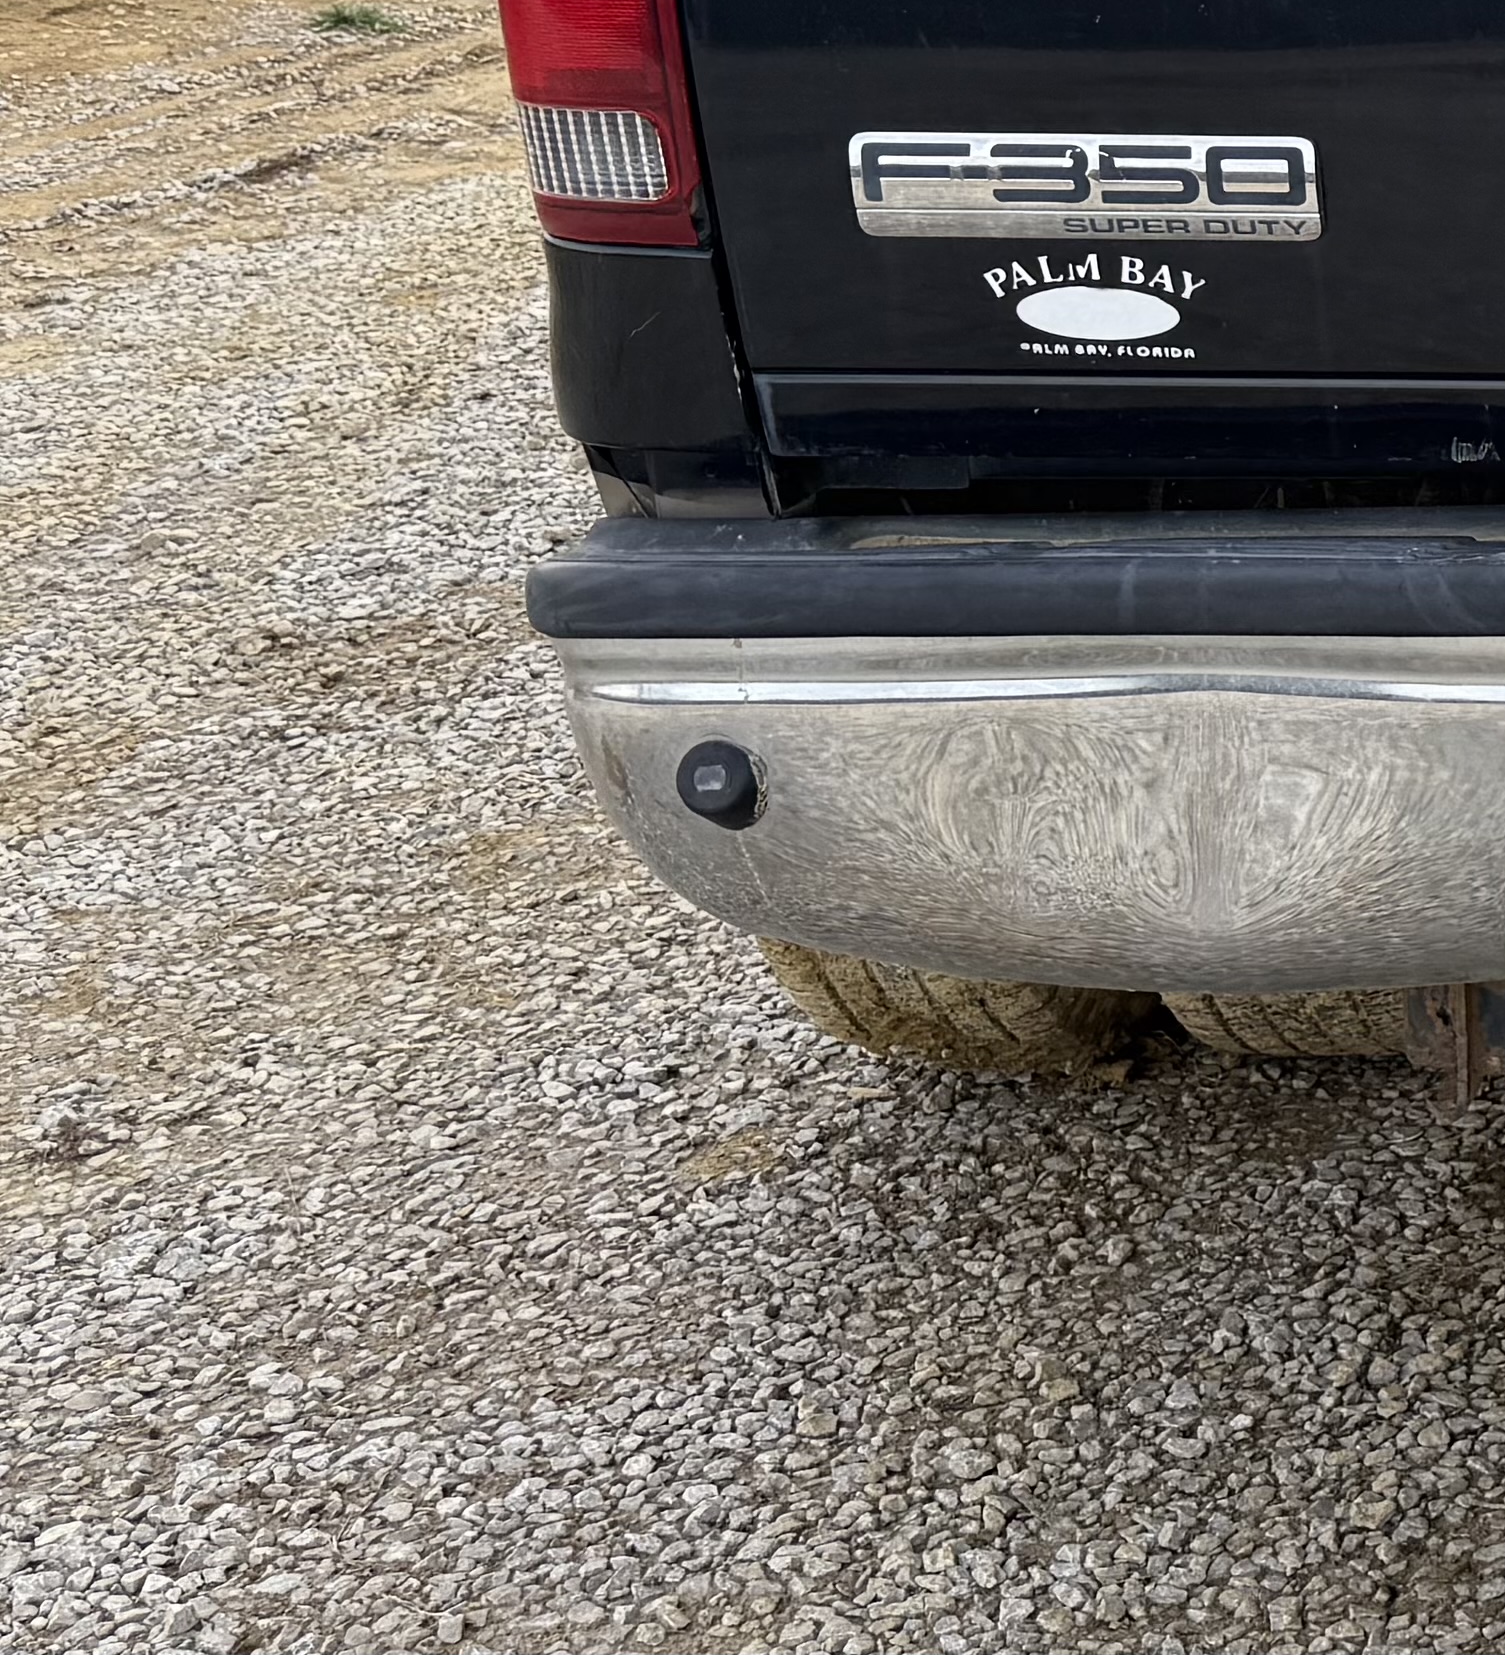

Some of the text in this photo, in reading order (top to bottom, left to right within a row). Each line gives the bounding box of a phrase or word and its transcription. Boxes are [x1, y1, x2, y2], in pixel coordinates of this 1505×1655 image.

[861, 142, 1307, 206] F-350
[1063, 217, 1307, 236] SUPER DUTY
[983, 253, 1206, 300] PALM BAY
[1117, 345, 1196, 359] FLORIDA
